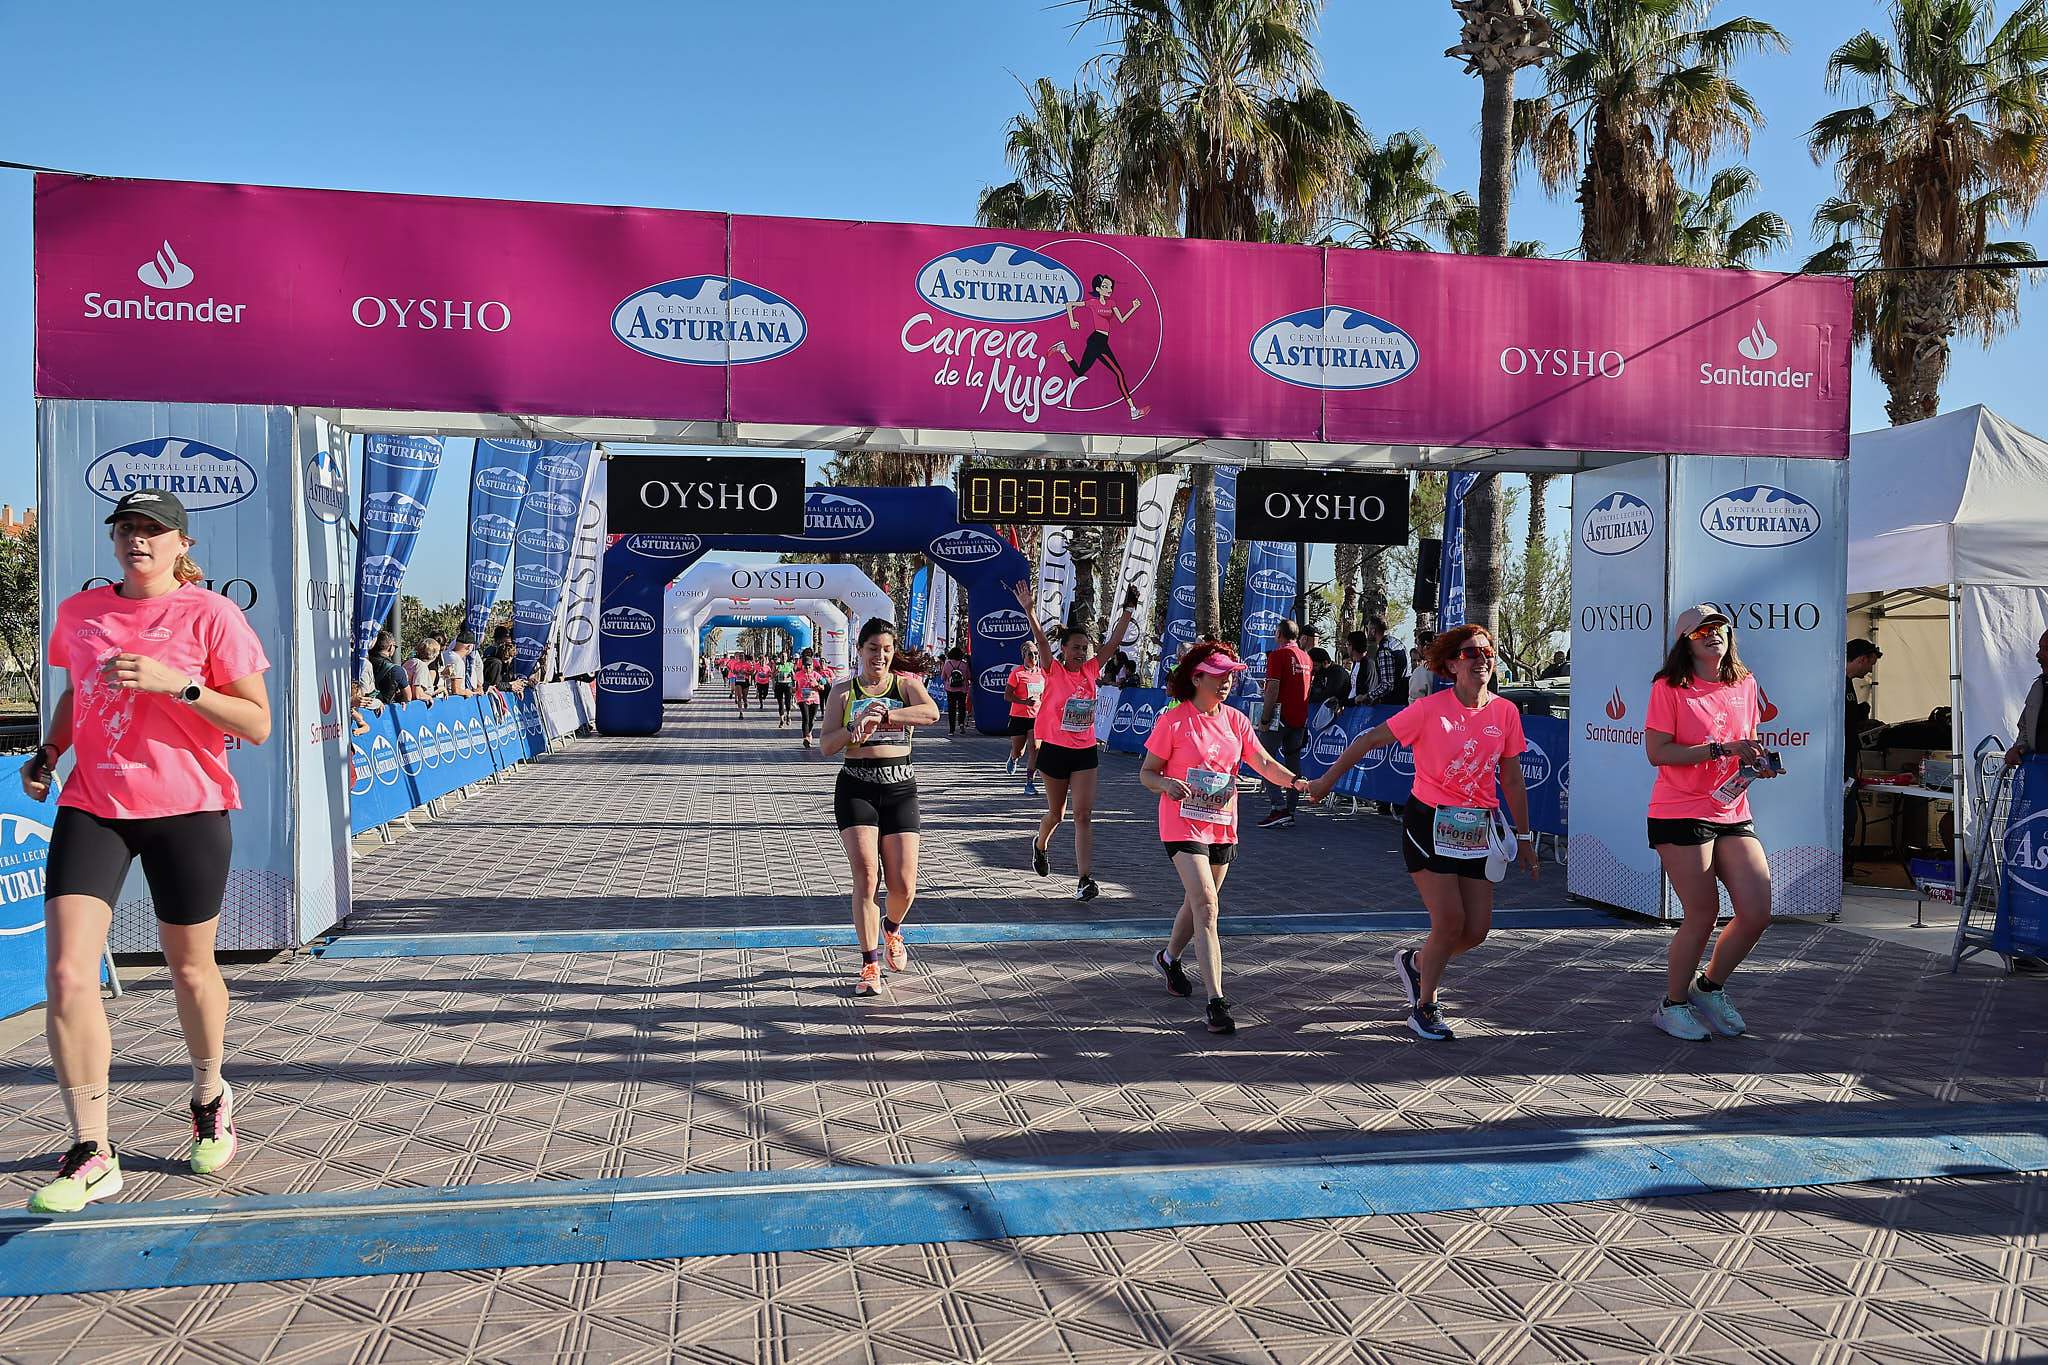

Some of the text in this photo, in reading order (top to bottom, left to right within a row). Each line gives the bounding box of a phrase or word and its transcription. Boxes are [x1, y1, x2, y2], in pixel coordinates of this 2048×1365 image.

[929, 268, 1069, 305] ASTURIANA
[954, 267, 1066, 282] CENTRAL LECHERA
[83, 291, 246, 324] Santander
[351, 295, 512, 333] OYSHO
[656, 304, 718, 315] CENTRAL
[626, 305, 793, 344] ASTURIANA
[900, 312, 1039, 360] Carrera
[1263, 333, 1407, 370] ASTURIANA
[1289, 332, 1402, 346] CENTRAL LECHERA
[1499, 346, 1626, 379] OYSHO
[1699, 362, 1814, 389] Santander
[934, 356, 1089, 424] de la Mujer
[99, 462, 245, 494] ASTURIANA
[125, 462, 240, 473] CENTRAL LECHERA
[640, 480, 778, 511] OYSHO
[971, 478, 1124, 516] 00:36:51
[1264, 491, 1385, 521] OYSHO
[805, 514, 866, 530] URIANA
[1708, 507, 1812, 533] ASTURIANA
[1727, 506, 1808, 515] CENTRAL LECHERA
[631, 535, 696, 550] ASTURIANA
[1586, 517, 1649, 543] ASTURIANA
[936, 539, 998, 555] ASTURIANA
[731, 570, 825, 590] OYSHO
[306, 578, 345, 613] OYSHO
[675, 590, 704, 598] OYSHO
[600, 618, 652, 631] ASTURIANA
[980, 621, 1029, 633] ASTURIANA
[1581, 603, 1652, 632] OYSHO
[1702, 600, 1820, 631] YSHO
[599, 673, 650, 687] ASTURIANA
[311, 721, 343, 745] Santande
[1585, 722, 1644, 746] Santander
